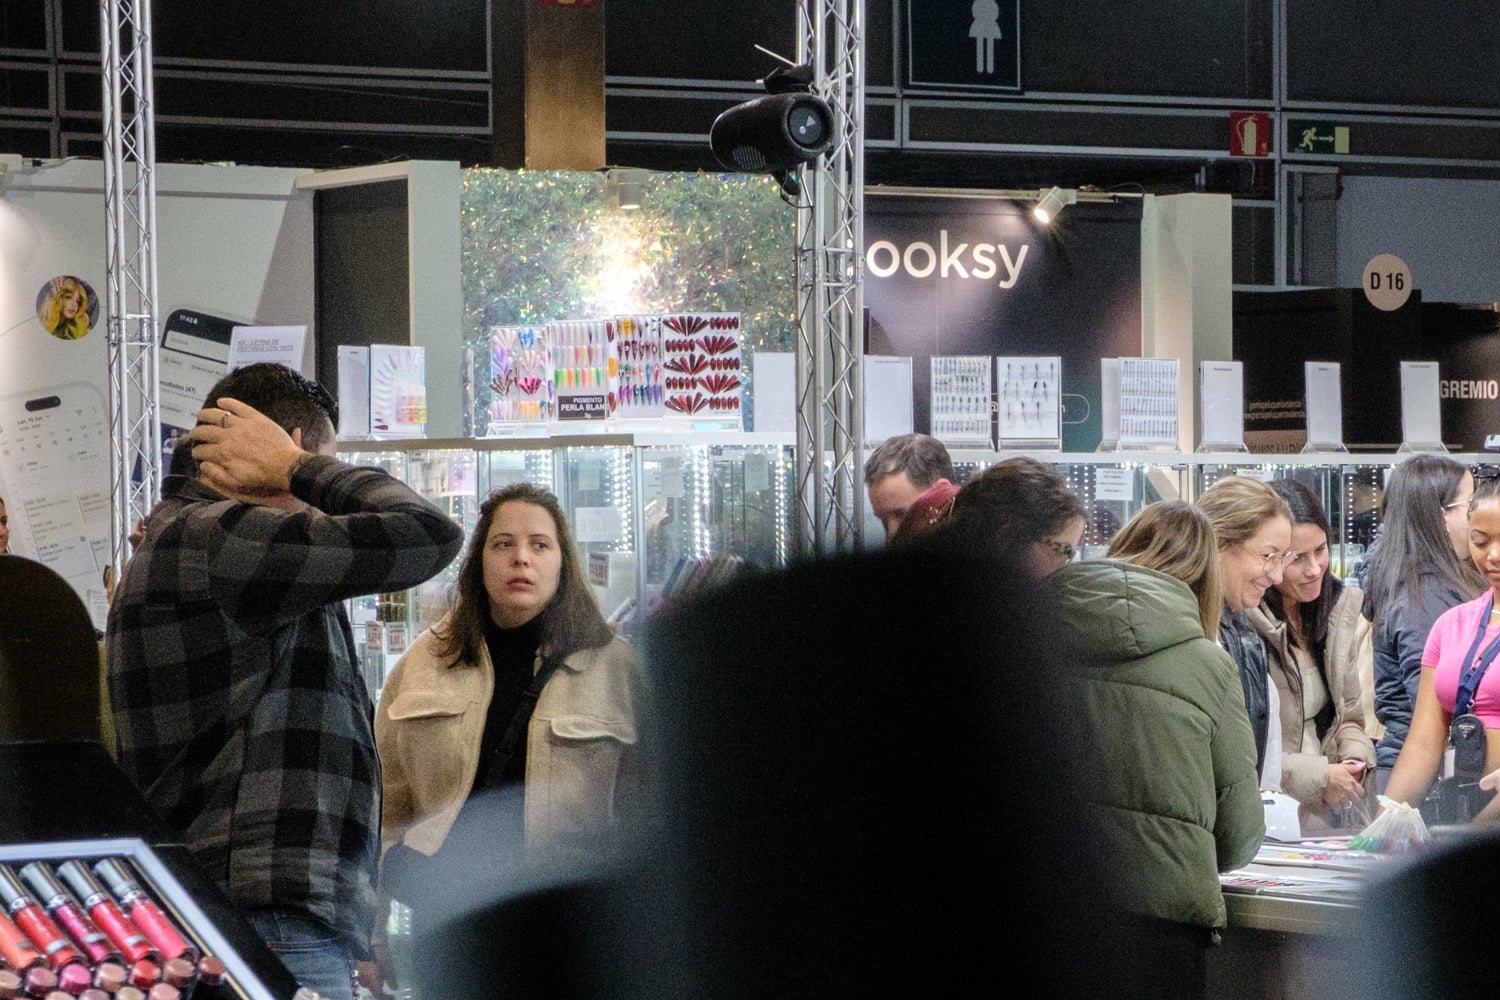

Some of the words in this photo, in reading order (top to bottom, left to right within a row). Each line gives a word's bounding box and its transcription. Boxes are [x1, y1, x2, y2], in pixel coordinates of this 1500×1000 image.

[847, 229, 1029, 289] ooksy
[1371, 272, 1381, 290] D
[1386, 272, 1404, 290] 16
[1440, 380, 1499, 400] GREMIO
